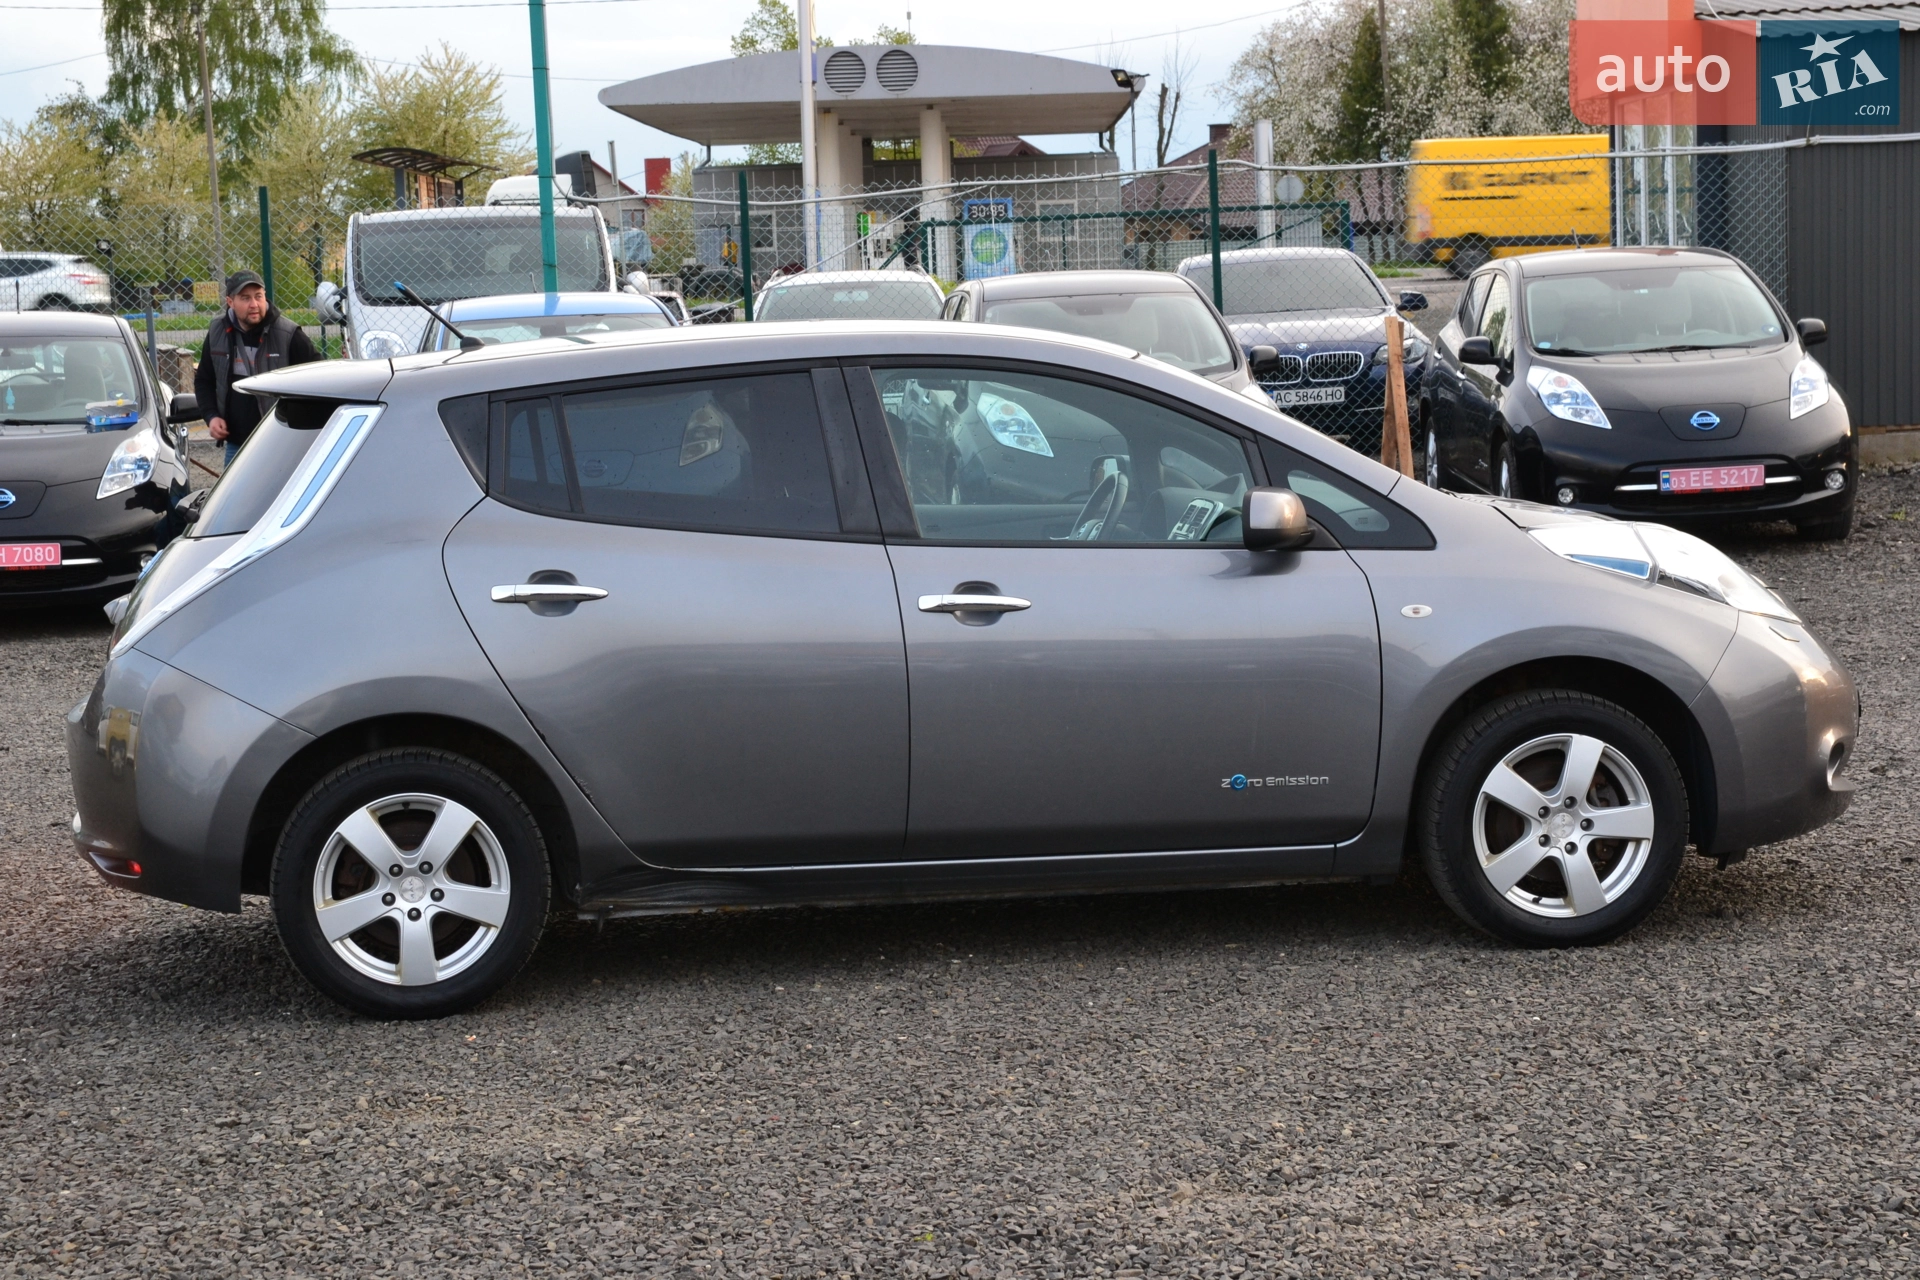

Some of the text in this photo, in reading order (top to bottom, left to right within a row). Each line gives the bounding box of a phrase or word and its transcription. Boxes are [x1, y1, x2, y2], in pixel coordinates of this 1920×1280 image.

[1275, 388, 1343, 404] AC 5846 HO
[1671, 468, 1759, 489] 03 EE 5217
[12, 546, 55, 563] 7080
[1265, 775, 1329, 786] Emission
